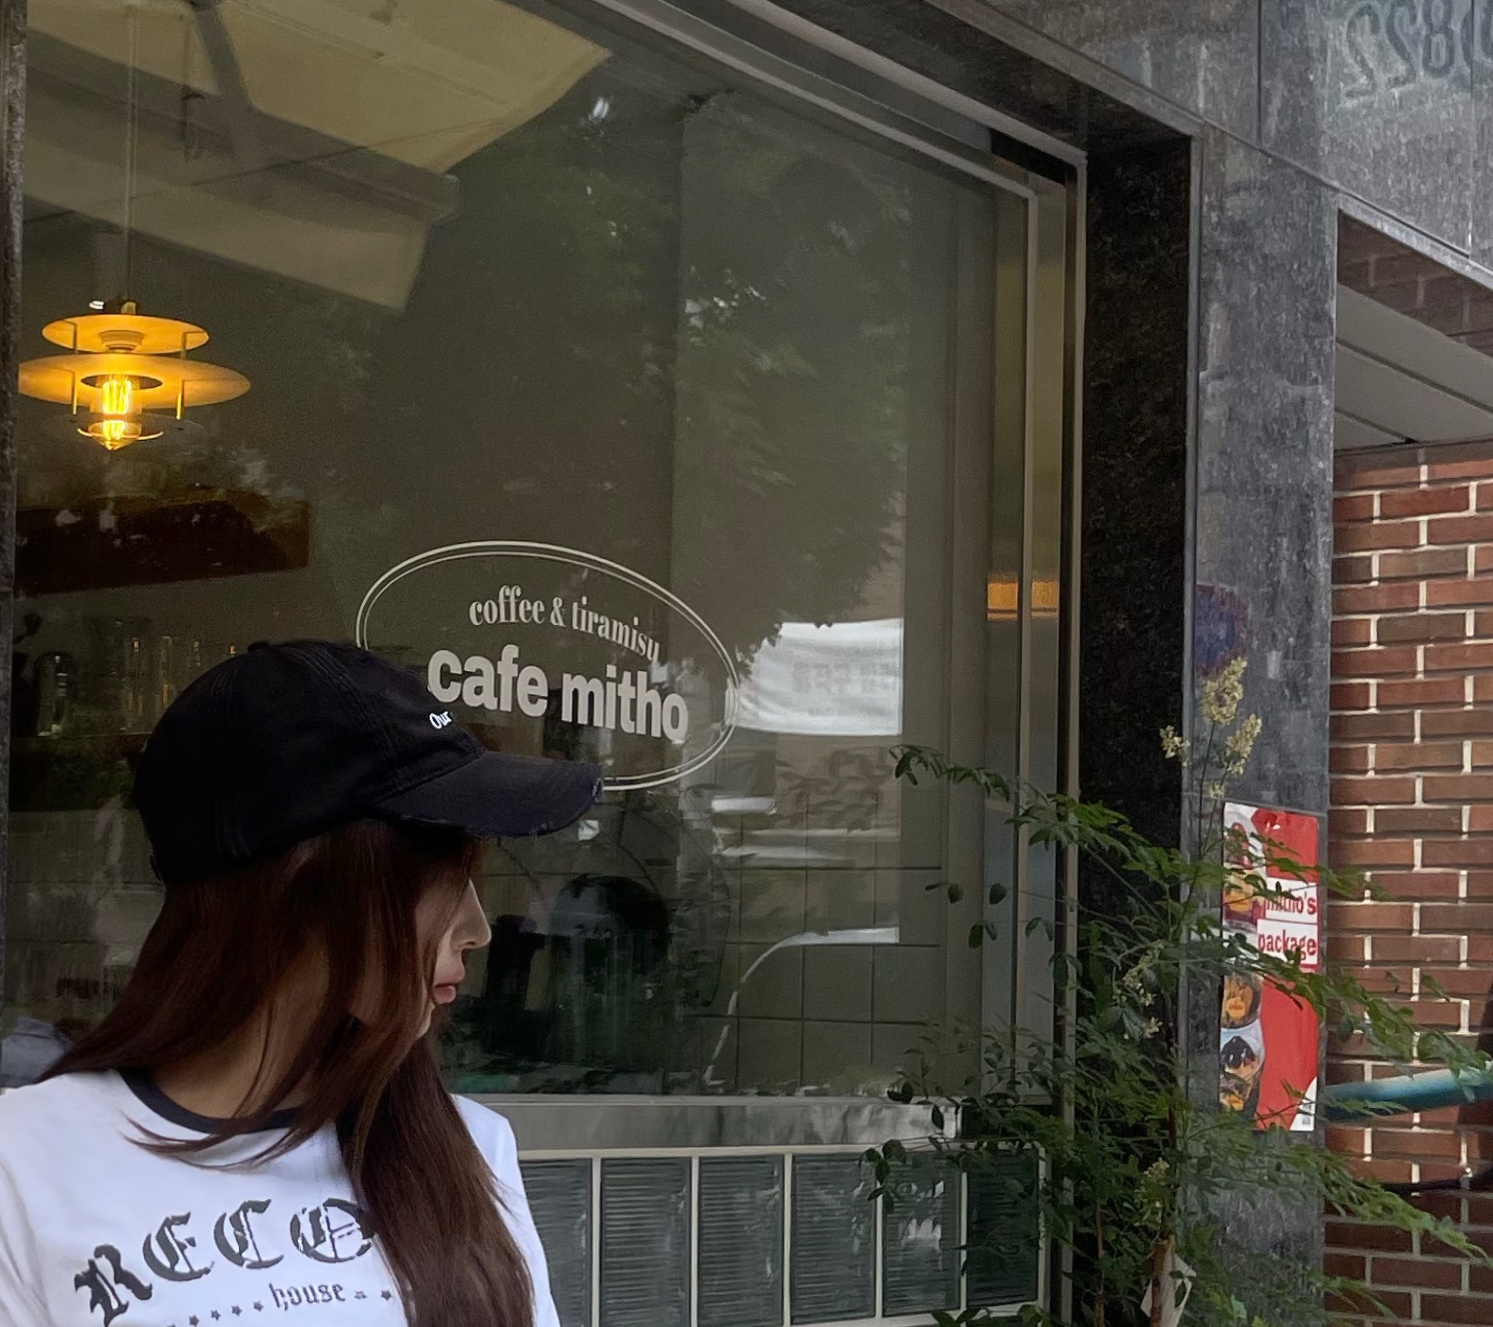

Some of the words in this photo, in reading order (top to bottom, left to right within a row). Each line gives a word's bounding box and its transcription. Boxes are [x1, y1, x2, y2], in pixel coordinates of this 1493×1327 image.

[468, 584, 546, 627] coffee
[550, 597, 566, 628] &
[571, 595, 660, 662] tiramisu
[427, 643, 549, 718] cafe
[561, 663, 689, 744] mitho
[1258, 929, 1317, 960] package
[269, 1281, 346, 1312] house
